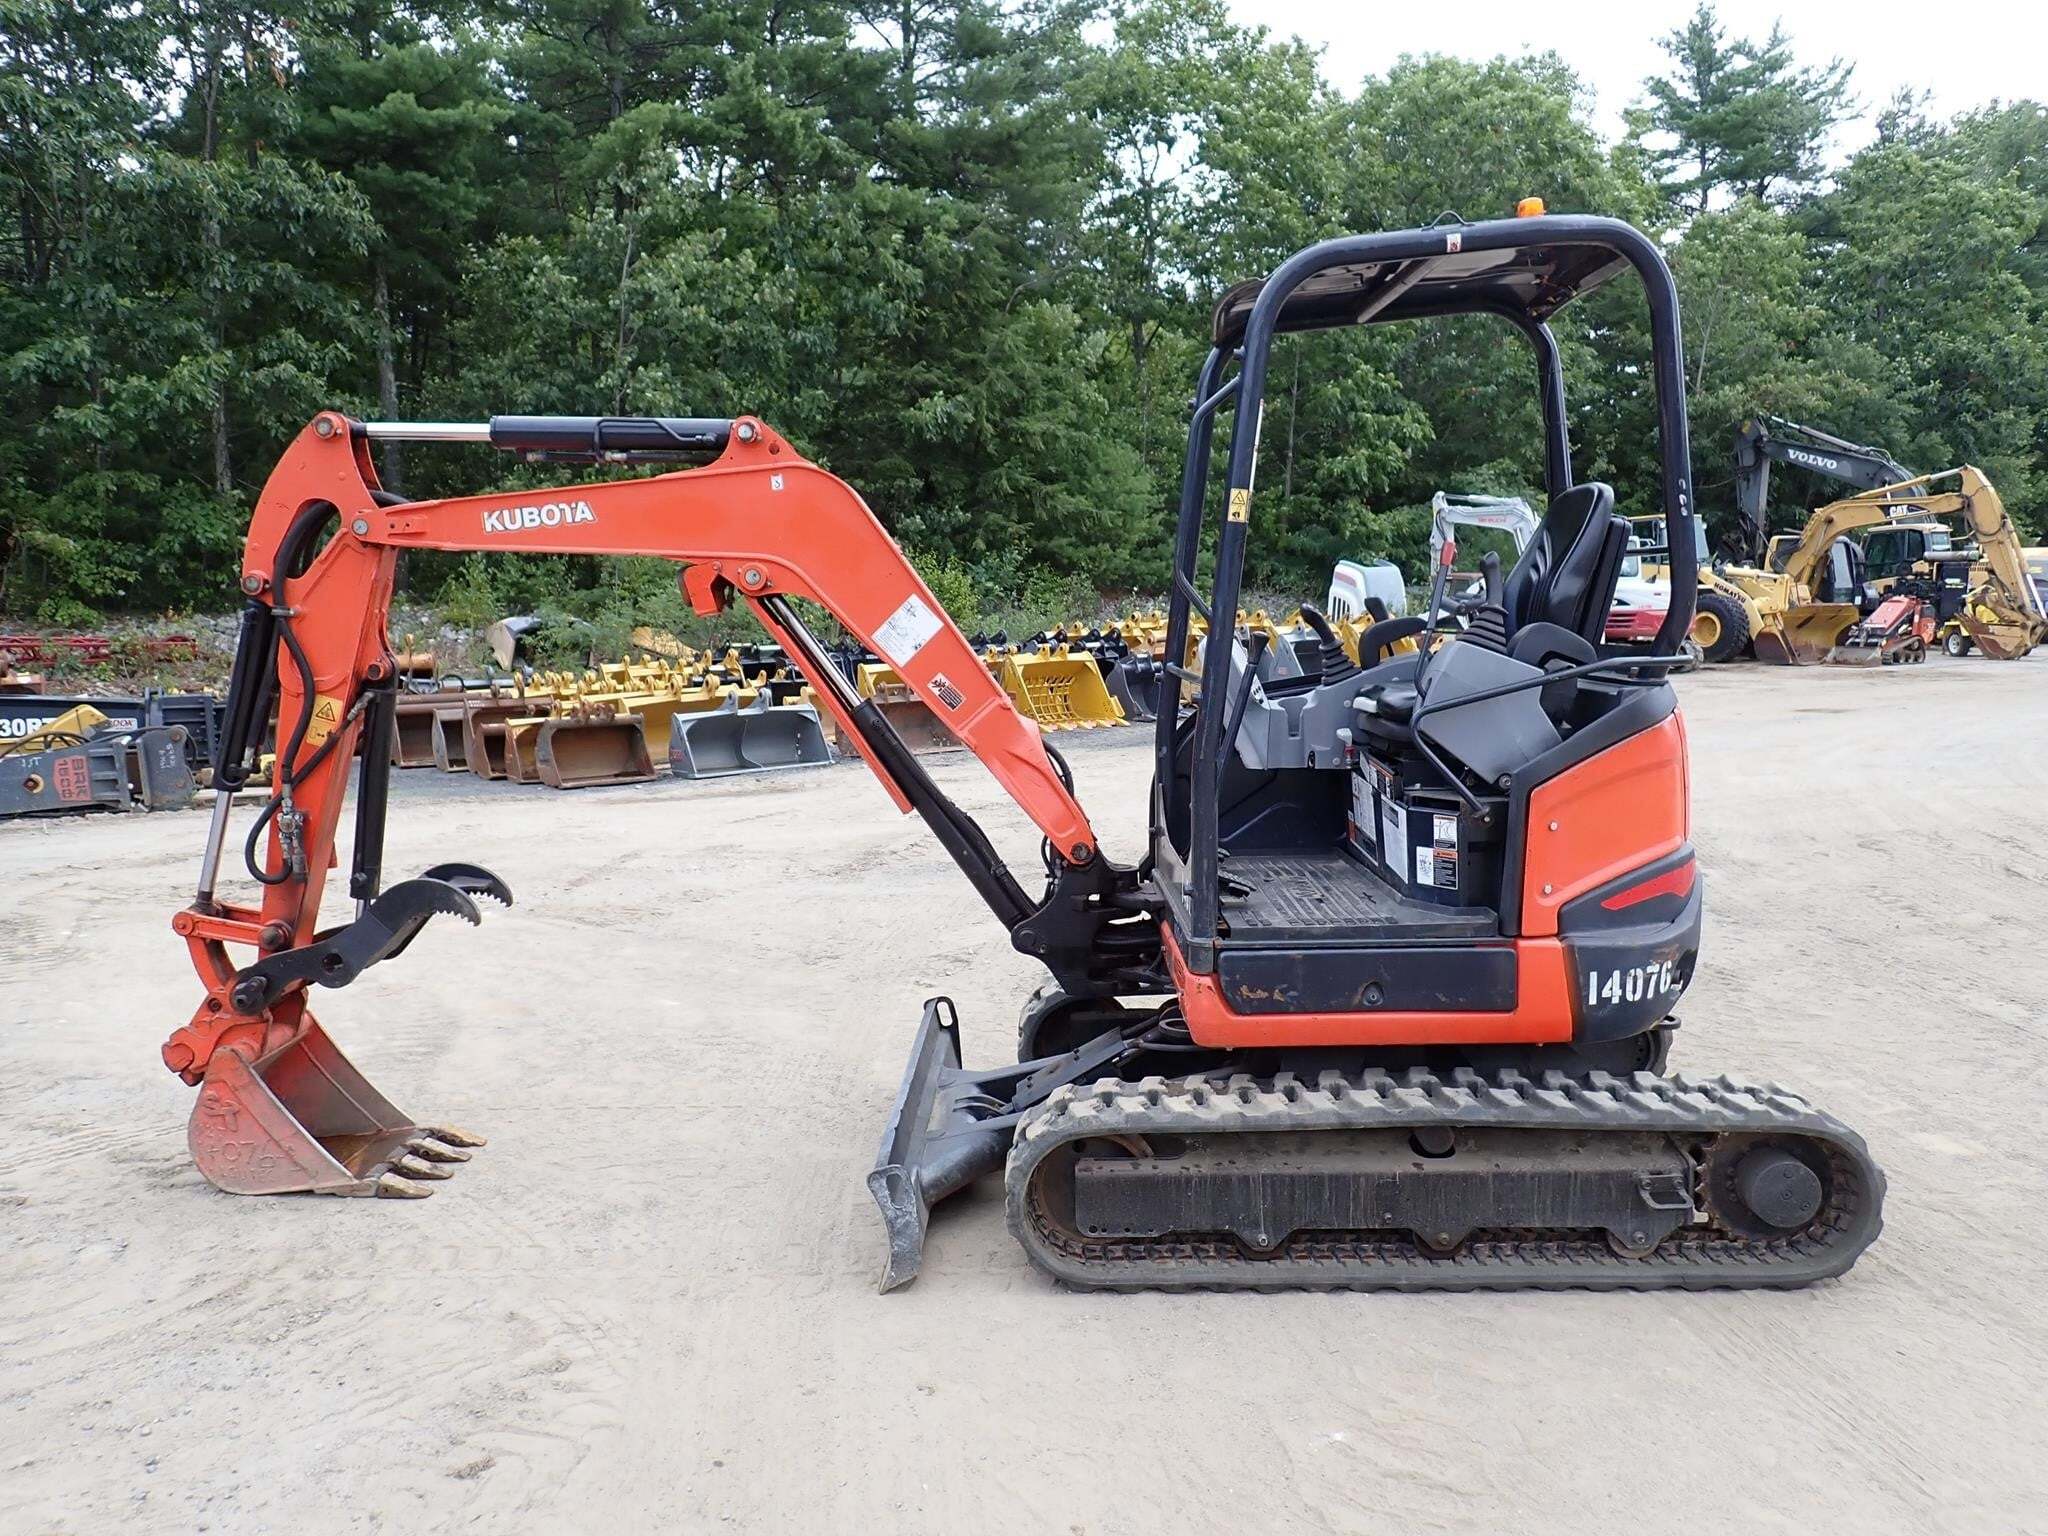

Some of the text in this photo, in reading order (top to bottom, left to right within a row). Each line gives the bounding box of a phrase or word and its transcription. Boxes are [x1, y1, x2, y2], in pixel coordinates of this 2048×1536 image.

[1788, 449, 1838, 470] VOLVO
[483, 501, 595, 532] KUBOTA
[1889, 504, 1908, 518] CAT
